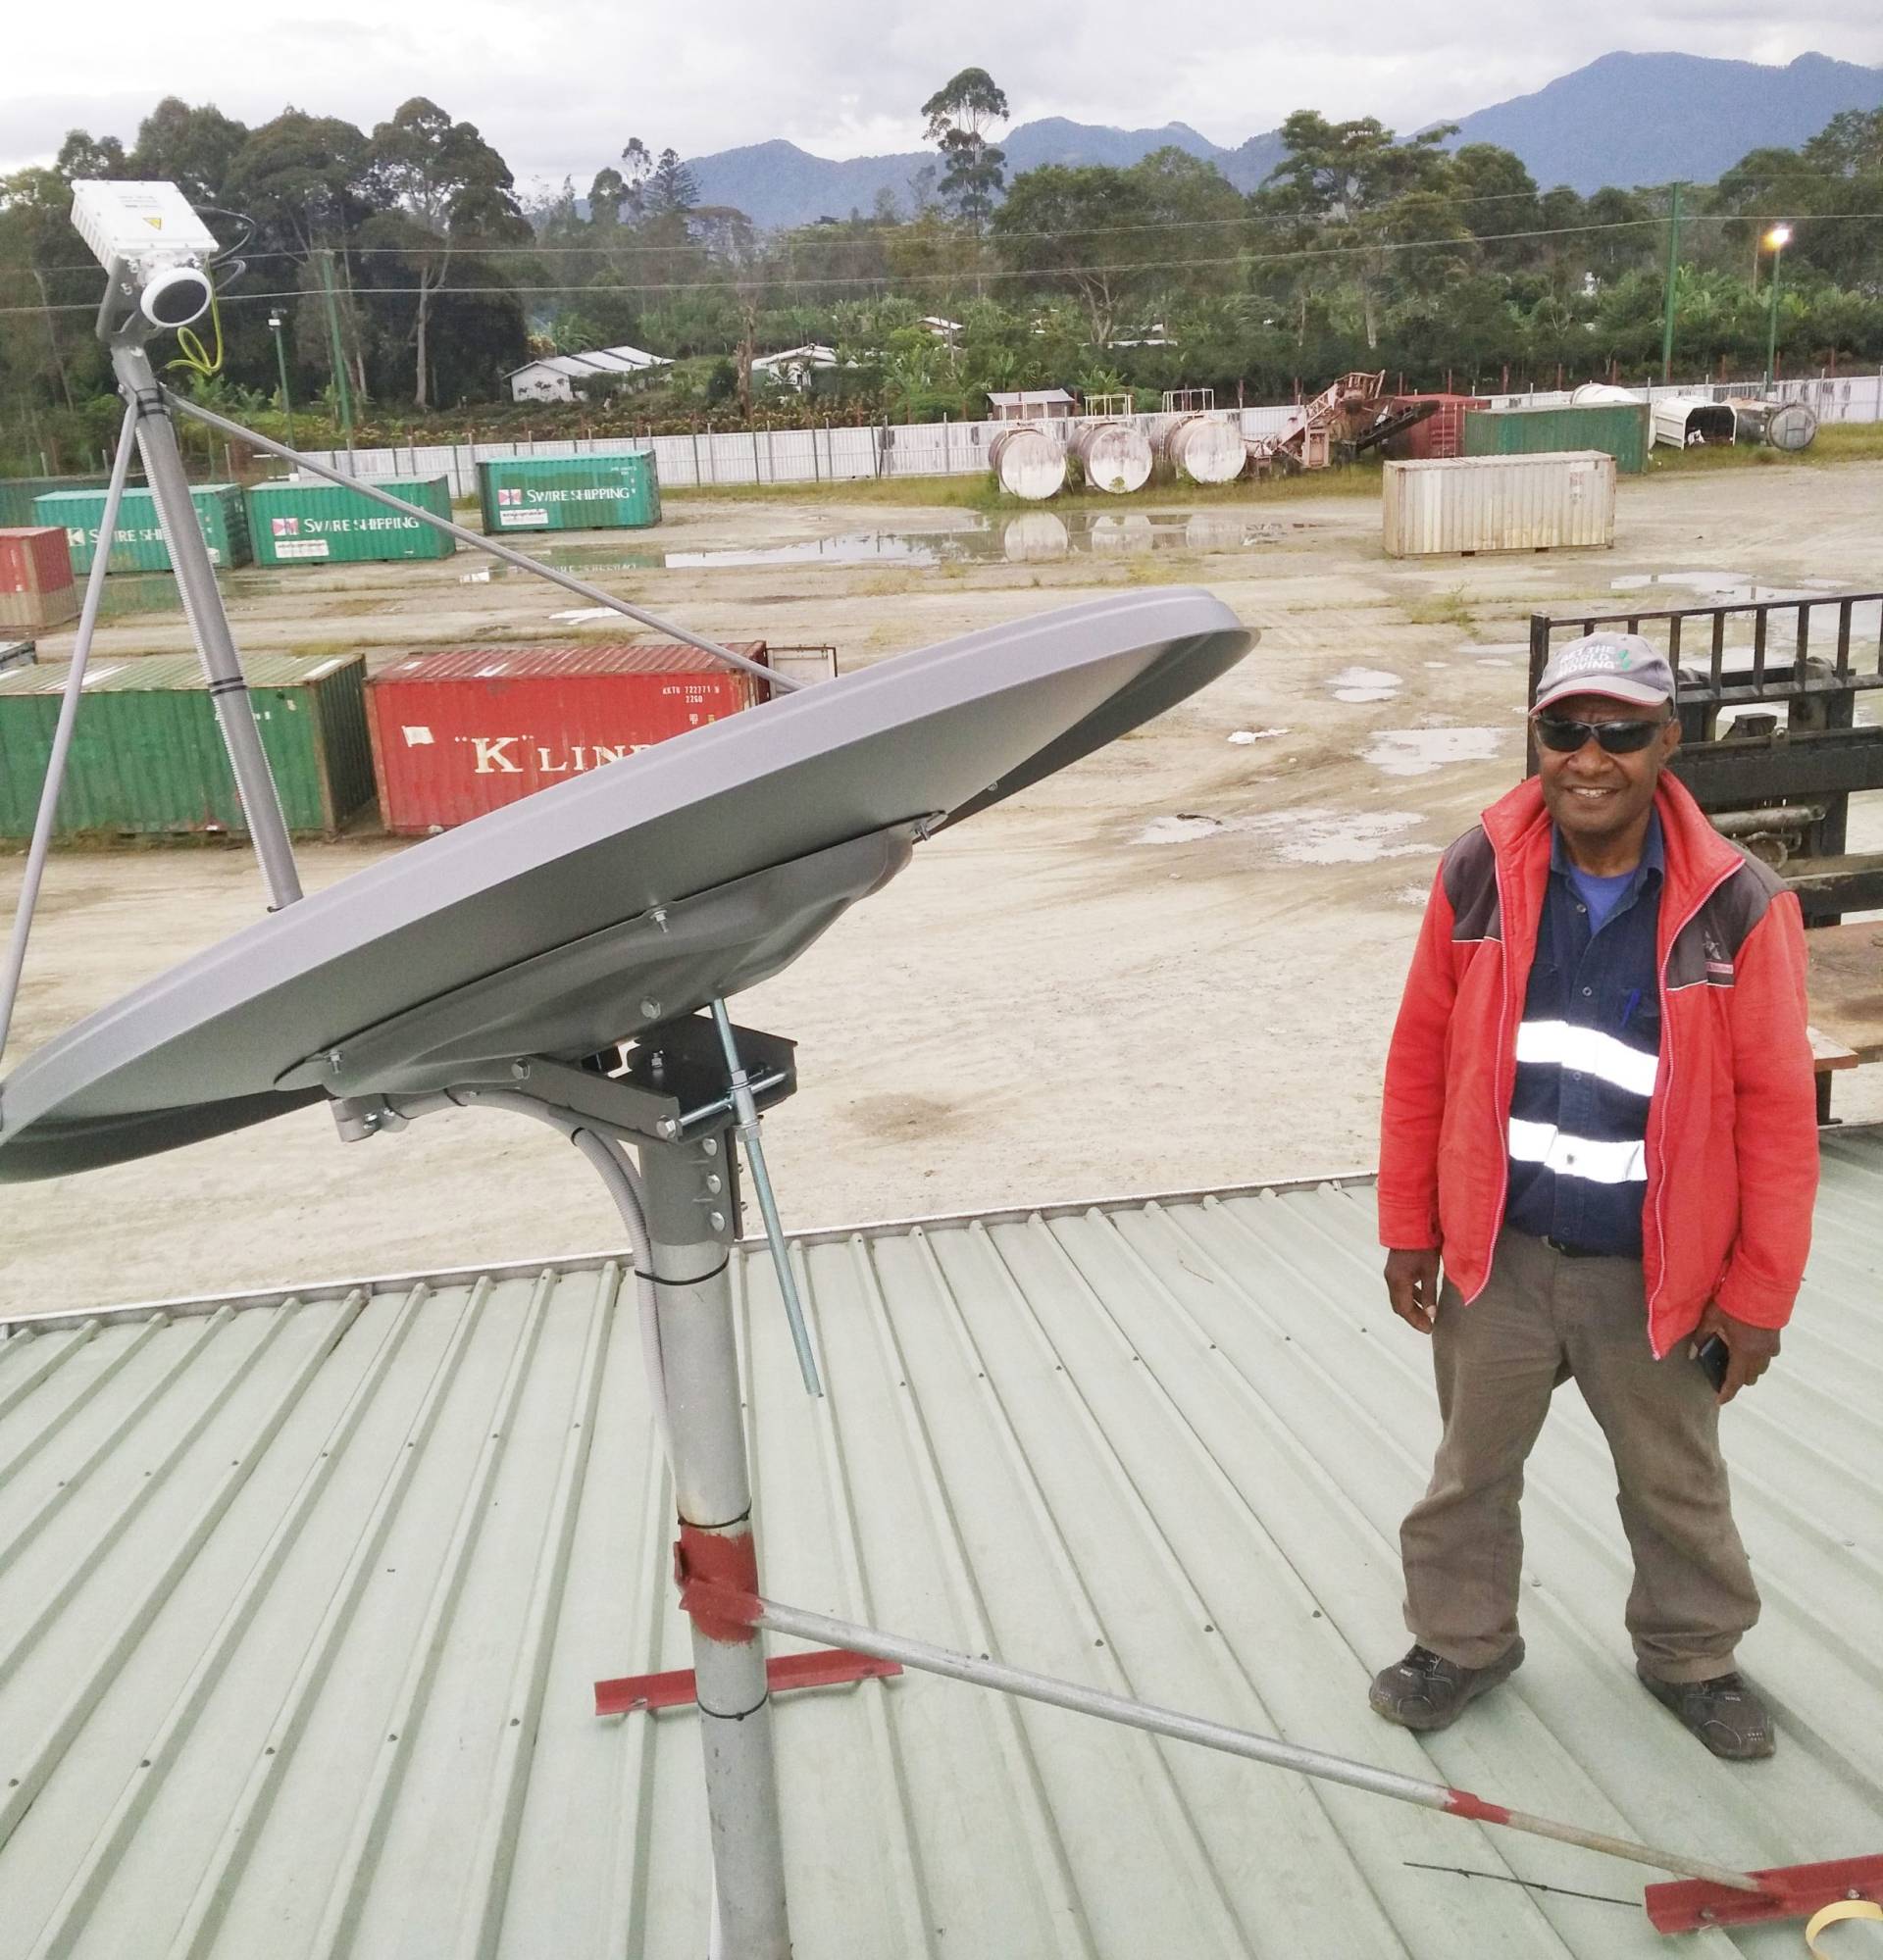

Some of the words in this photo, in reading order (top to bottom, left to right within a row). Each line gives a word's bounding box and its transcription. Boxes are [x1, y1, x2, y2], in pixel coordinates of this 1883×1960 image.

[527, 489, 570, 503] SWIRE
[571, 487, 630, 501] SHIPPING
[303, 518, 350, 533] SWIRE
[353, 516, 420, 531] SHIPPING
[88, 528, 136, 543] SIRE
